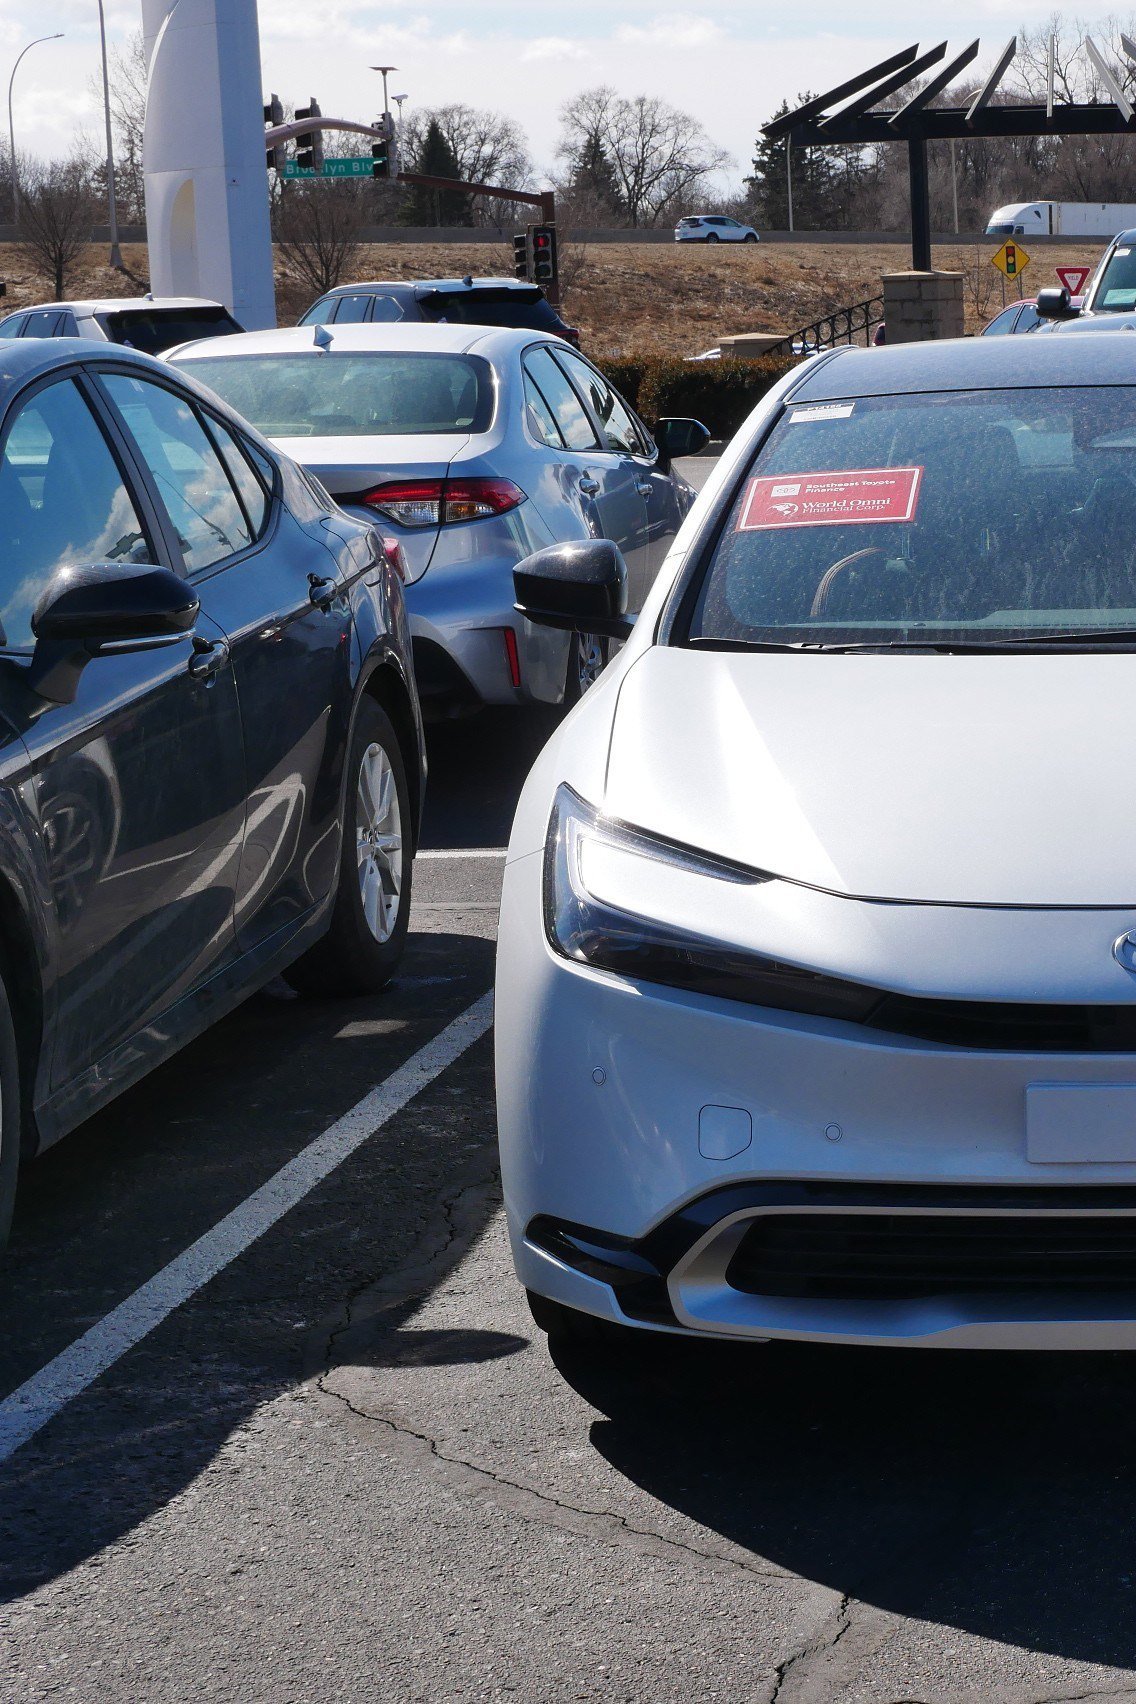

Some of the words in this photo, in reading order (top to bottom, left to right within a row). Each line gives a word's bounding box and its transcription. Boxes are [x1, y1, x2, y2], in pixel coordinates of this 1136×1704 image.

[285, 163, 346, 175] Broolyn
[351, 161, 374, 172] Blv
[806, 481, 860, 489] Southeast
[802, 500, 847, 508] World
